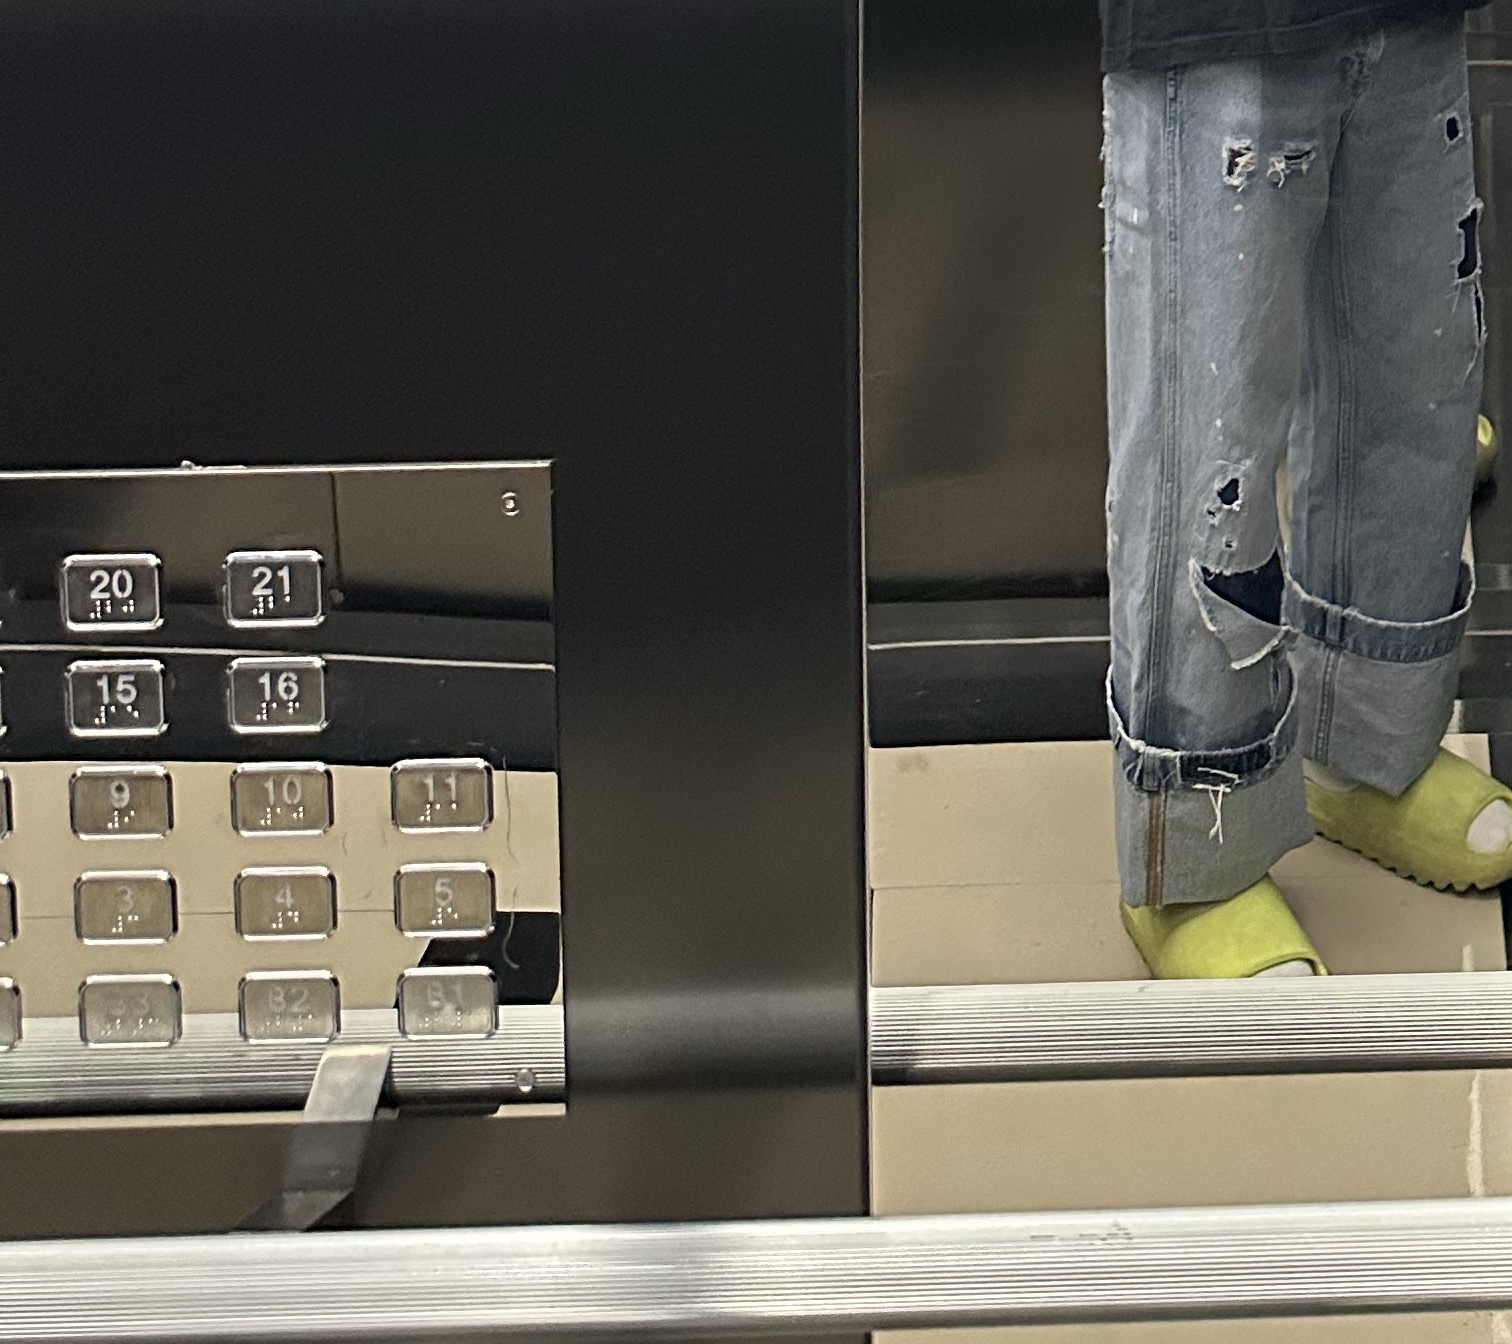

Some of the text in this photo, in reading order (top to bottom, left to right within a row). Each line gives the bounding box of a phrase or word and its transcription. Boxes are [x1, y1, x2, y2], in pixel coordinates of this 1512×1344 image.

[89, 569, 134, 600] 20
[251, 566, 293, 597] 21
[96, 675, 138, 705] 15
[259, 671, 300, 701] 16
[109, 780, 131, 809] 9
[263, 776, 302, 805] 10
[422, 772, 460, 801] 11
[274, 884, 294, 910] 4
[434, 878, 454, 905] 5
